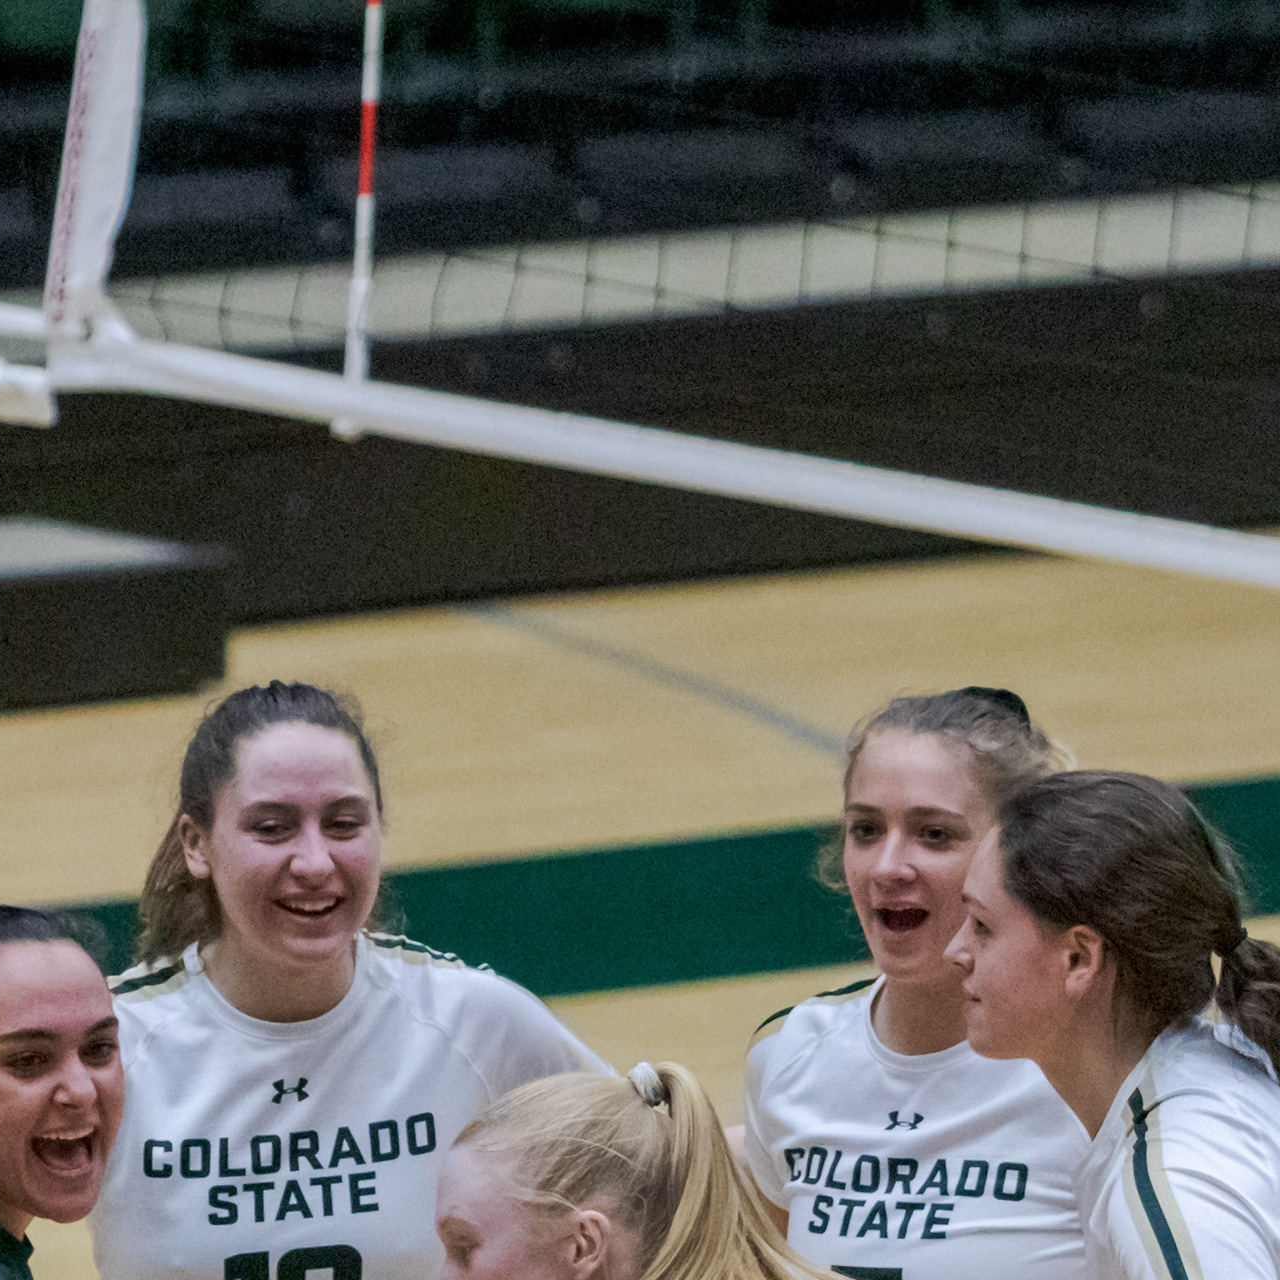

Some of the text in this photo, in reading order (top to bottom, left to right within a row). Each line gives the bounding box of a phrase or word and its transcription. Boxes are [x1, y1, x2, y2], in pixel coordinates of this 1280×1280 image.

[143, 1112, 437, 1180] COLORADO
[783, 1145, 1029, 1202] COLORADO
[207, 1170, 380, 1226] STATE
[807, 1194, 955, 1240] STATE
